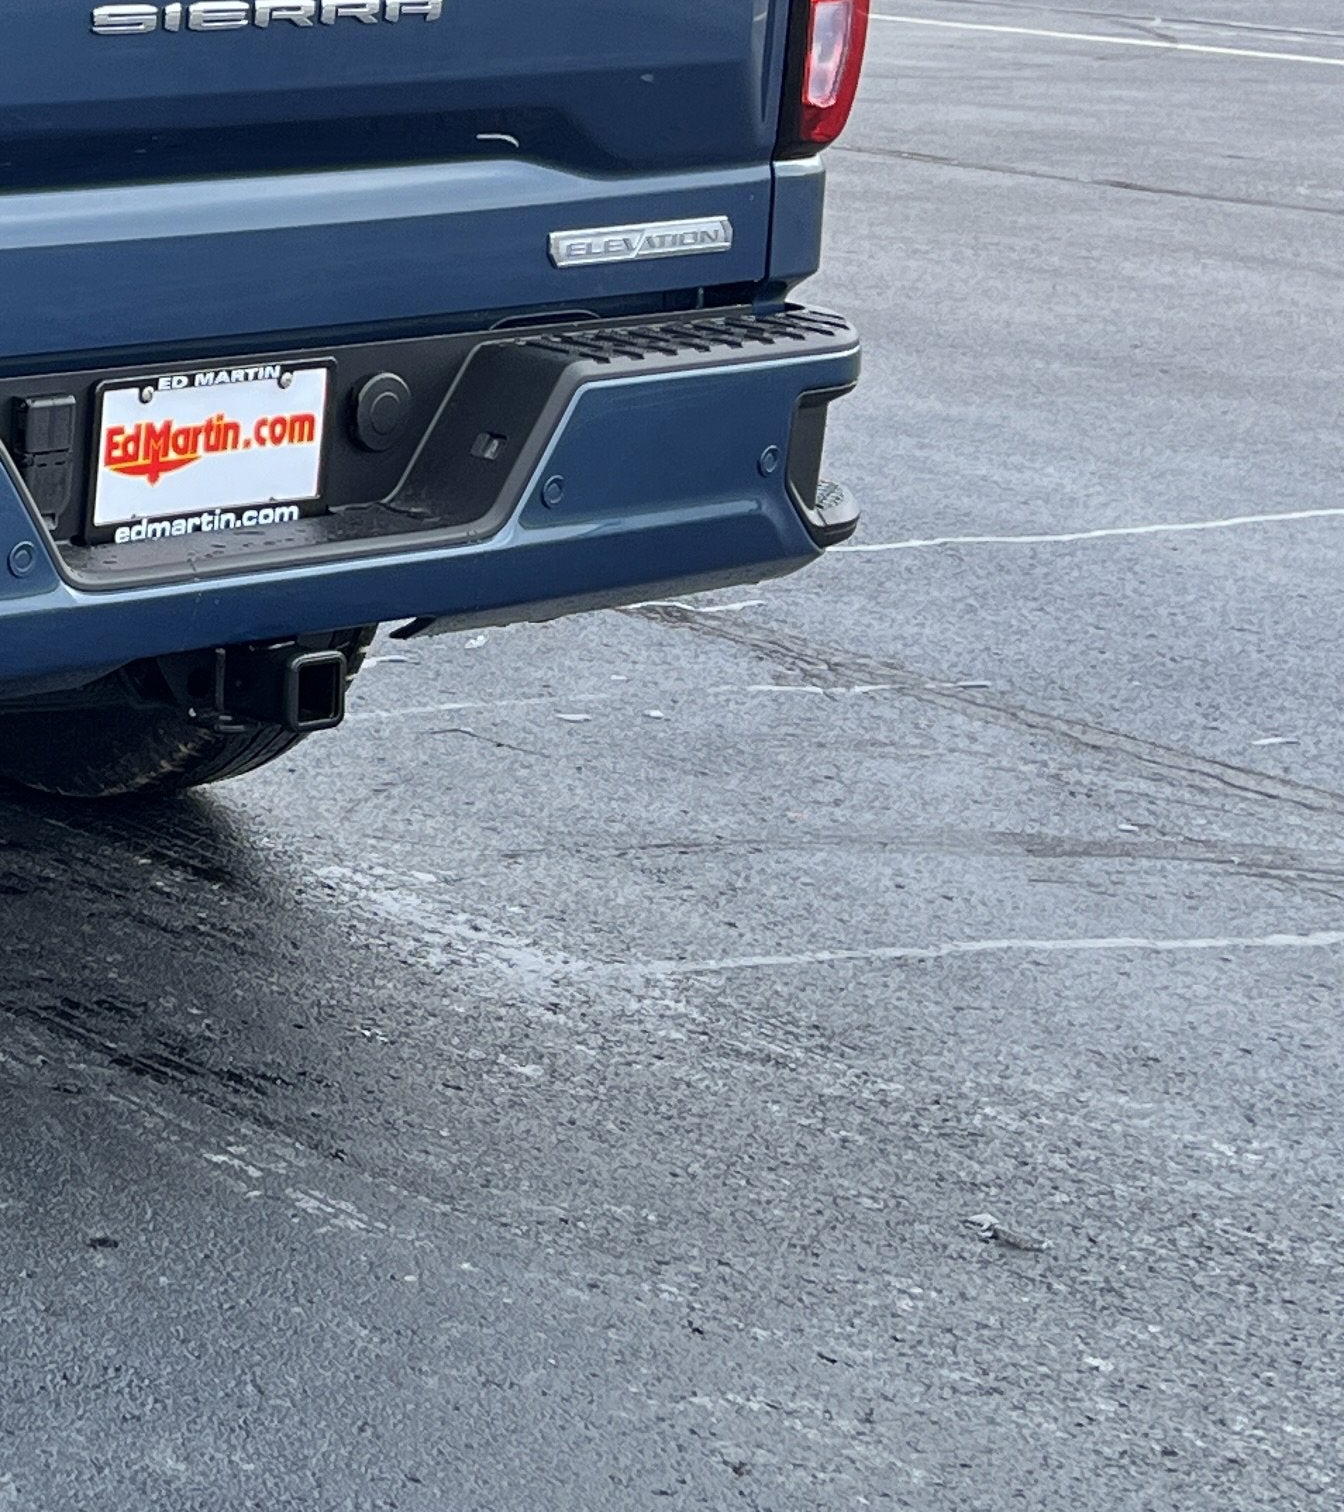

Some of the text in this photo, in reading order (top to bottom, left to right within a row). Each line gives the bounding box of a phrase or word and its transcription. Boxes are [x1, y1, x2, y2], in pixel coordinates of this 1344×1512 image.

[566, 229, 720, 257] ELEVATION
[157, 365, 282, 391] ED MARTIN
[105, 413, 315, 466] EdMartin.com
[114, 504, 299, 544] edmartin.com
